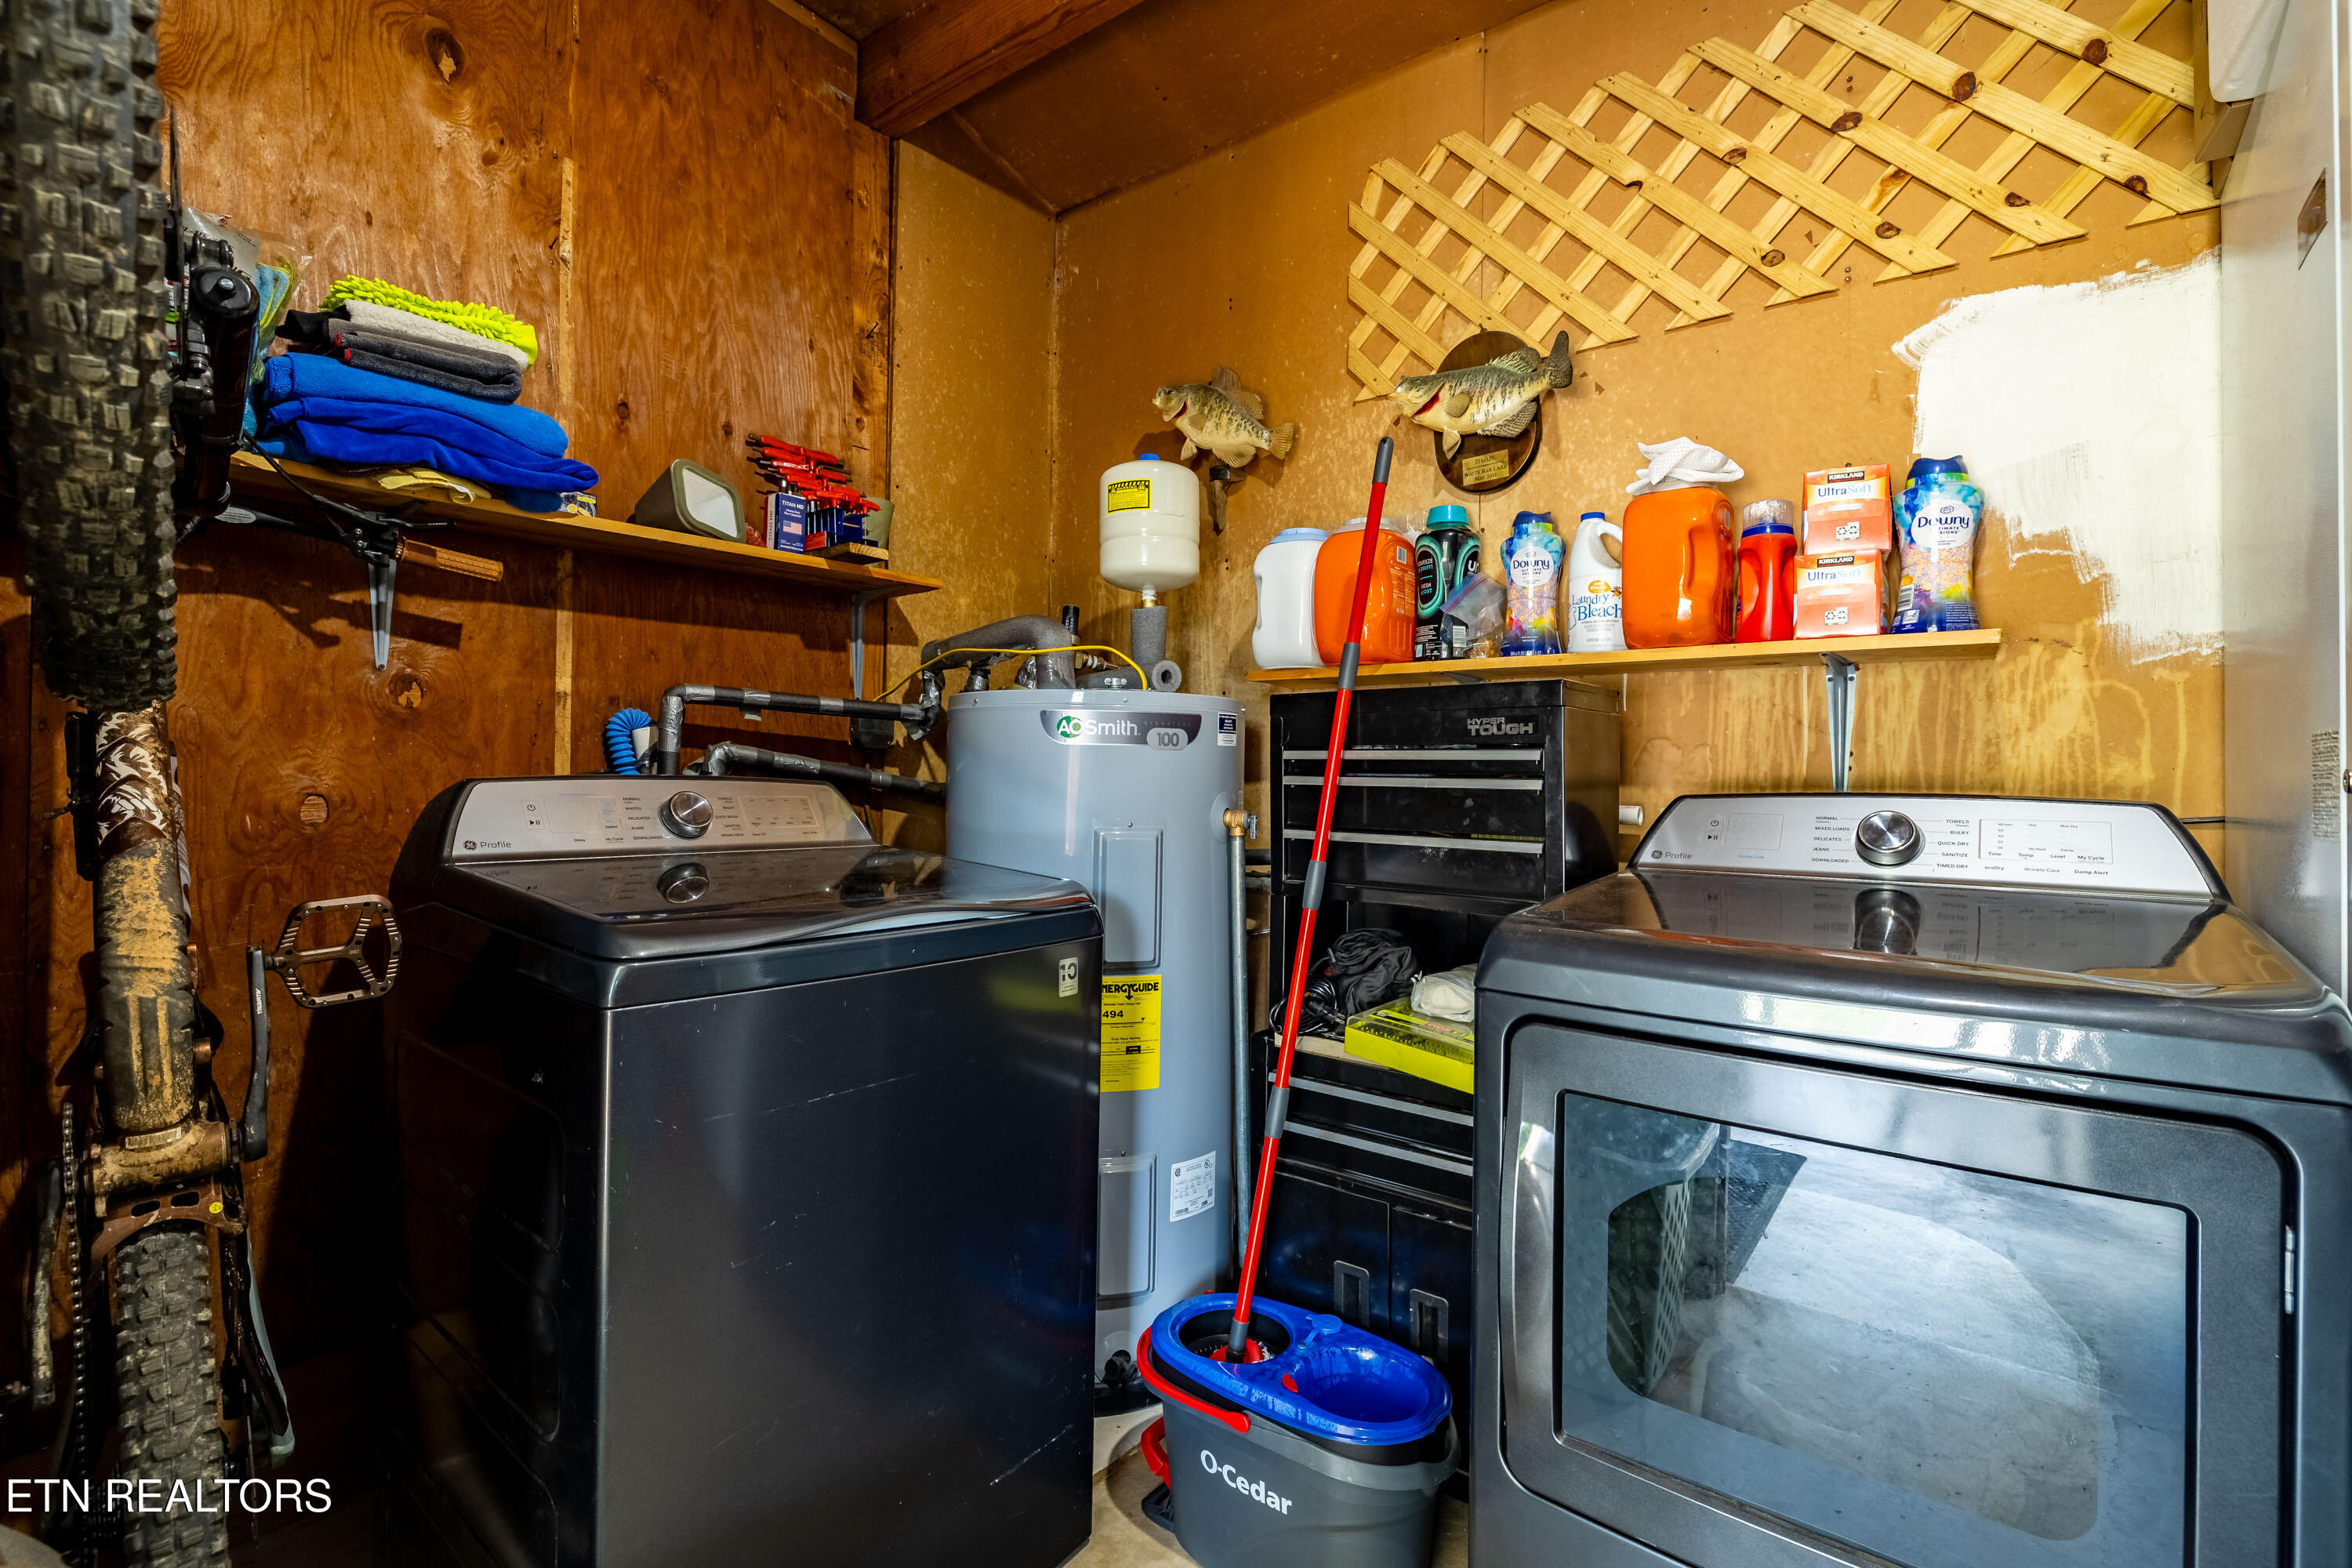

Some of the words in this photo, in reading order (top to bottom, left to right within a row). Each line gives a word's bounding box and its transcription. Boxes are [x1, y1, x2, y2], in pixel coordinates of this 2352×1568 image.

[1828, 471, 1864, 480] KIRKLAND
[769, 510, 774, 521] HD
[1512, 560, 1550, 570] Downy
[1572, 593, 1610, 605] Laundry
[1577, 603, 1622, 622] Bleach
[1467, 717, 1505, 725] HYPER
[1467, 722, 1534, 736] TOUGH
[1156, 731, 1180, 747] 100
[1059, 962, 1078, 982] 10
[1102, 982, 1160, 995] NERGYGUIDE
[1201, 1450, 1293, 1515] O-Cedar
